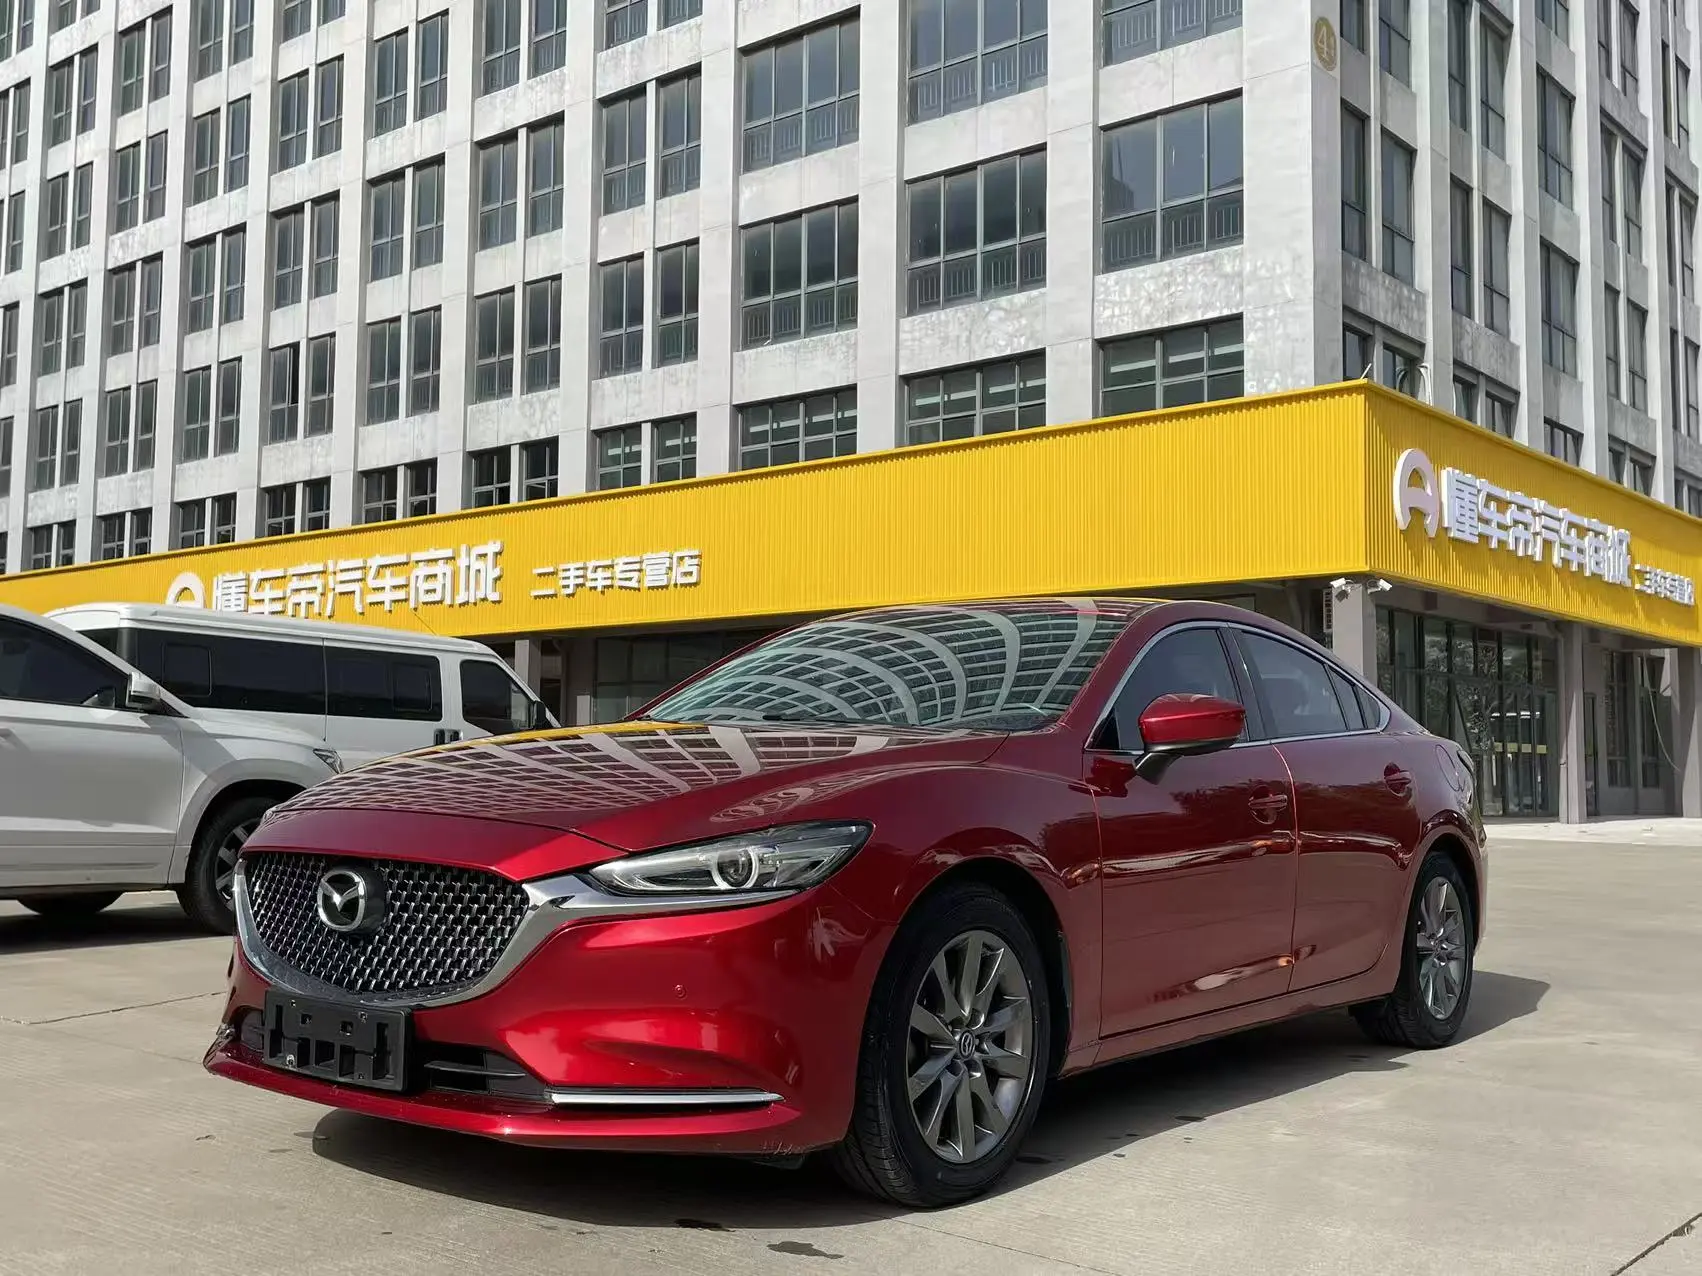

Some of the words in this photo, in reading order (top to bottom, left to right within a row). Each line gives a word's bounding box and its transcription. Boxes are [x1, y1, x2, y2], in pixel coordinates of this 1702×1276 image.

[1440, 467, 1632, 588] 懂车帝汽车商城
[212, 540, 504, 618] 懂车帝汽车商城
[530, 549, 703, 598] 二手车专营店
